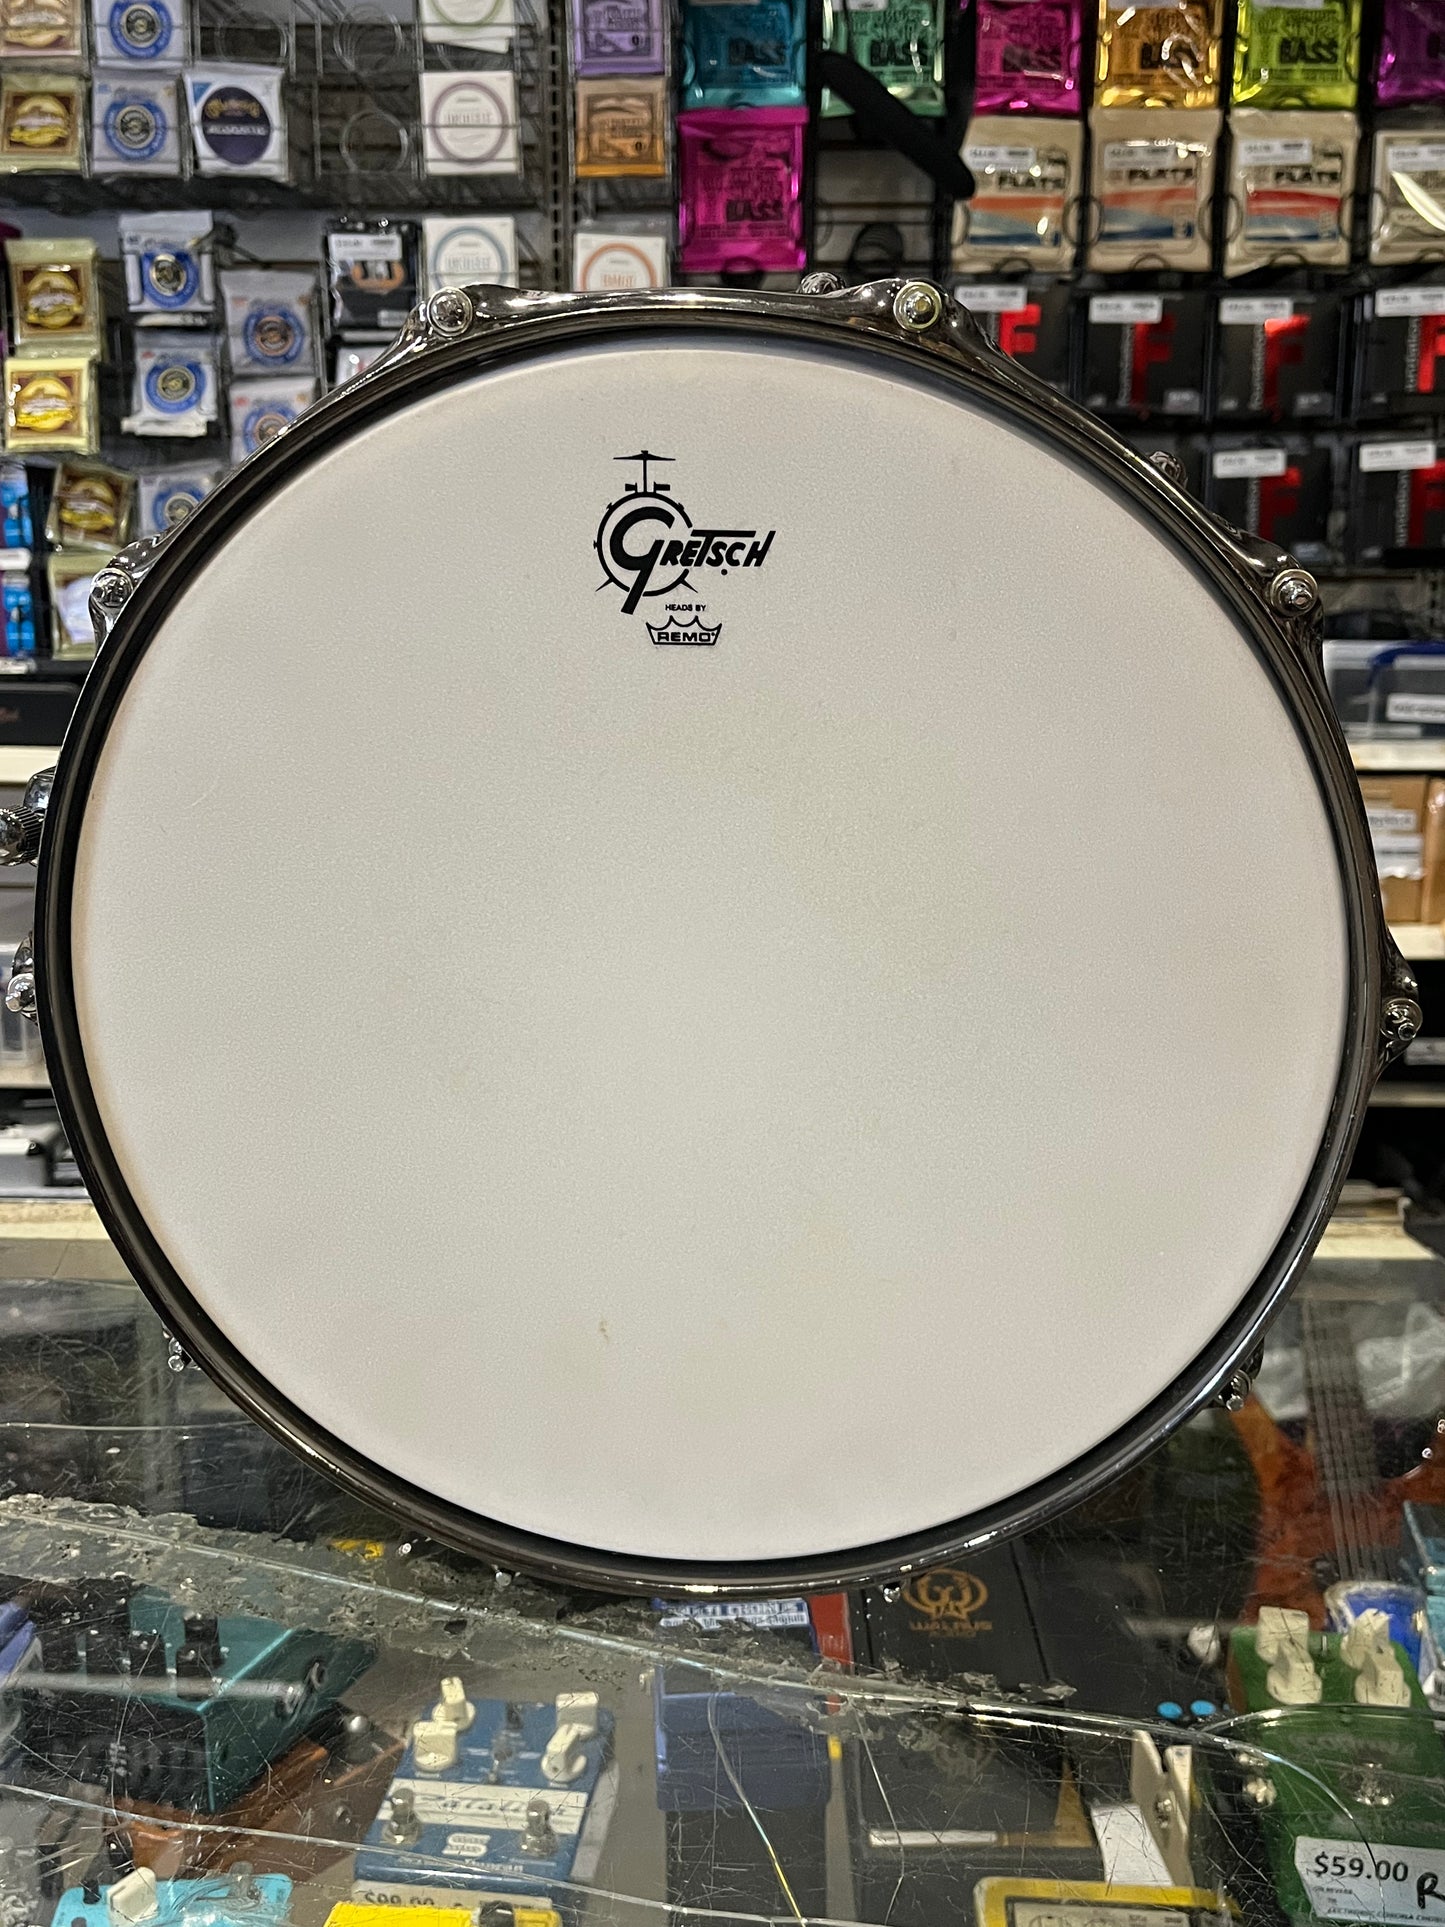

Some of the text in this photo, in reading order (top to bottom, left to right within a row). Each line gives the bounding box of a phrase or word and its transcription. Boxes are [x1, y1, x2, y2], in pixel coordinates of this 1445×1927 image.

[1278, 37, 1338, 64] BASS
[609, 506, 777, 616] GRETSCH
[657, 631, 711, 643] REMO
[1314, 1851, 1409, 1882] $59.00
